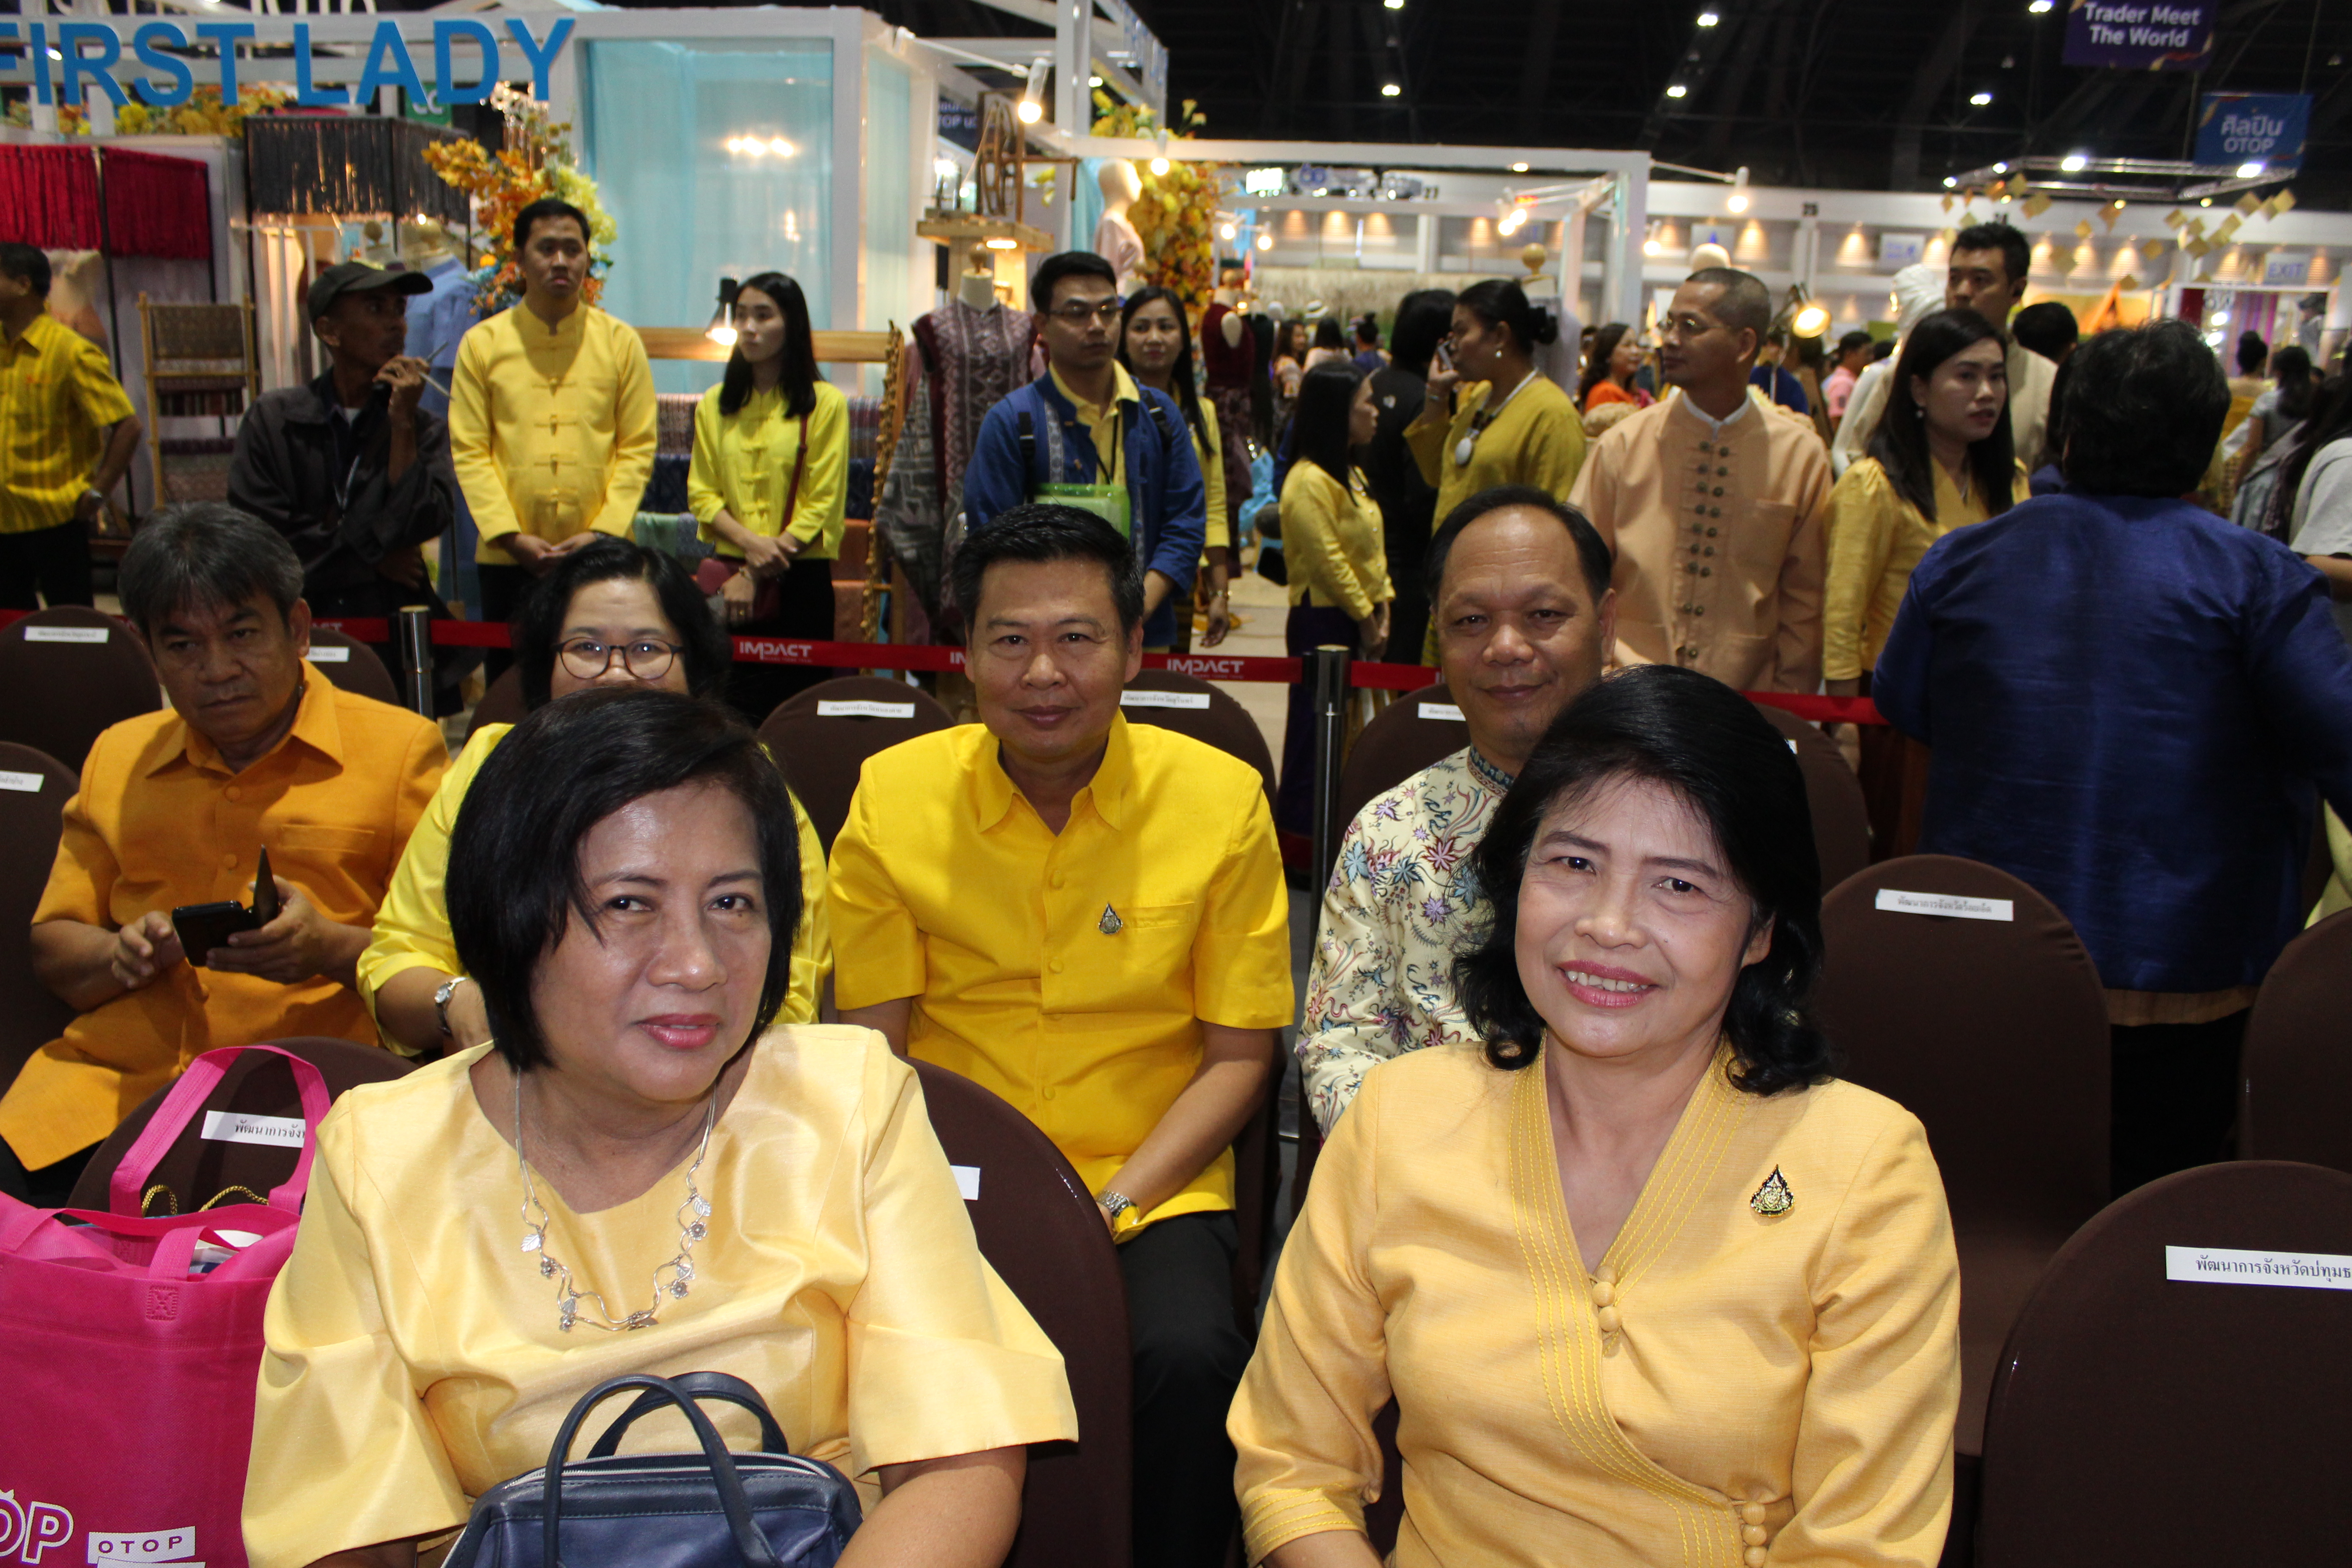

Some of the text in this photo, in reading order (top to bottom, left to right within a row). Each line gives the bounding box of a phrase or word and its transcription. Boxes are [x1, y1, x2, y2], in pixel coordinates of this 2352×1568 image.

[2084, 1, 2201, 26] Trader Meet
[2088, 24, 2190, 48] The World
[292, 17, 576, 107] LADY
[2224, 137, 2275, 153] OTOP
[739, 641, 812, 661] IMPACT
[1166, 658, 1245, 675] IMPACT
[98, 1535, 182, 1553] OTOP
